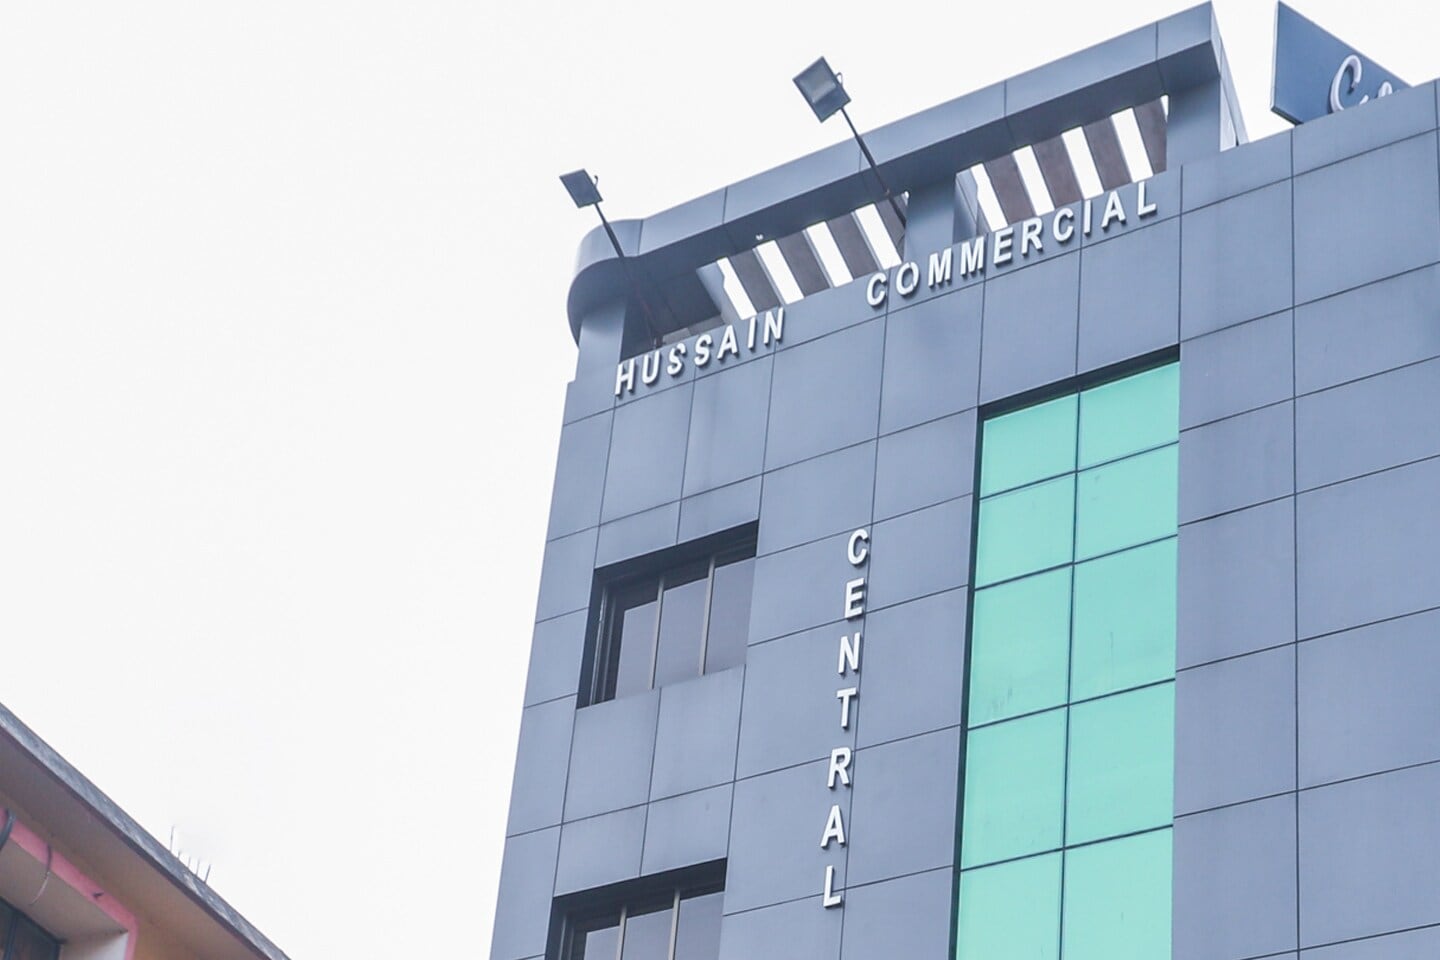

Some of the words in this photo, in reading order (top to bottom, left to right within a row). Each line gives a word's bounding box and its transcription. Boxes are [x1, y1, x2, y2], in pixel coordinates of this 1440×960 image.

[614, 307, 784, 395] HUSSAIN
[866, 180, 1158, 307] COMMERCIAL
[820, 528, 870, 909] CENTRAL
